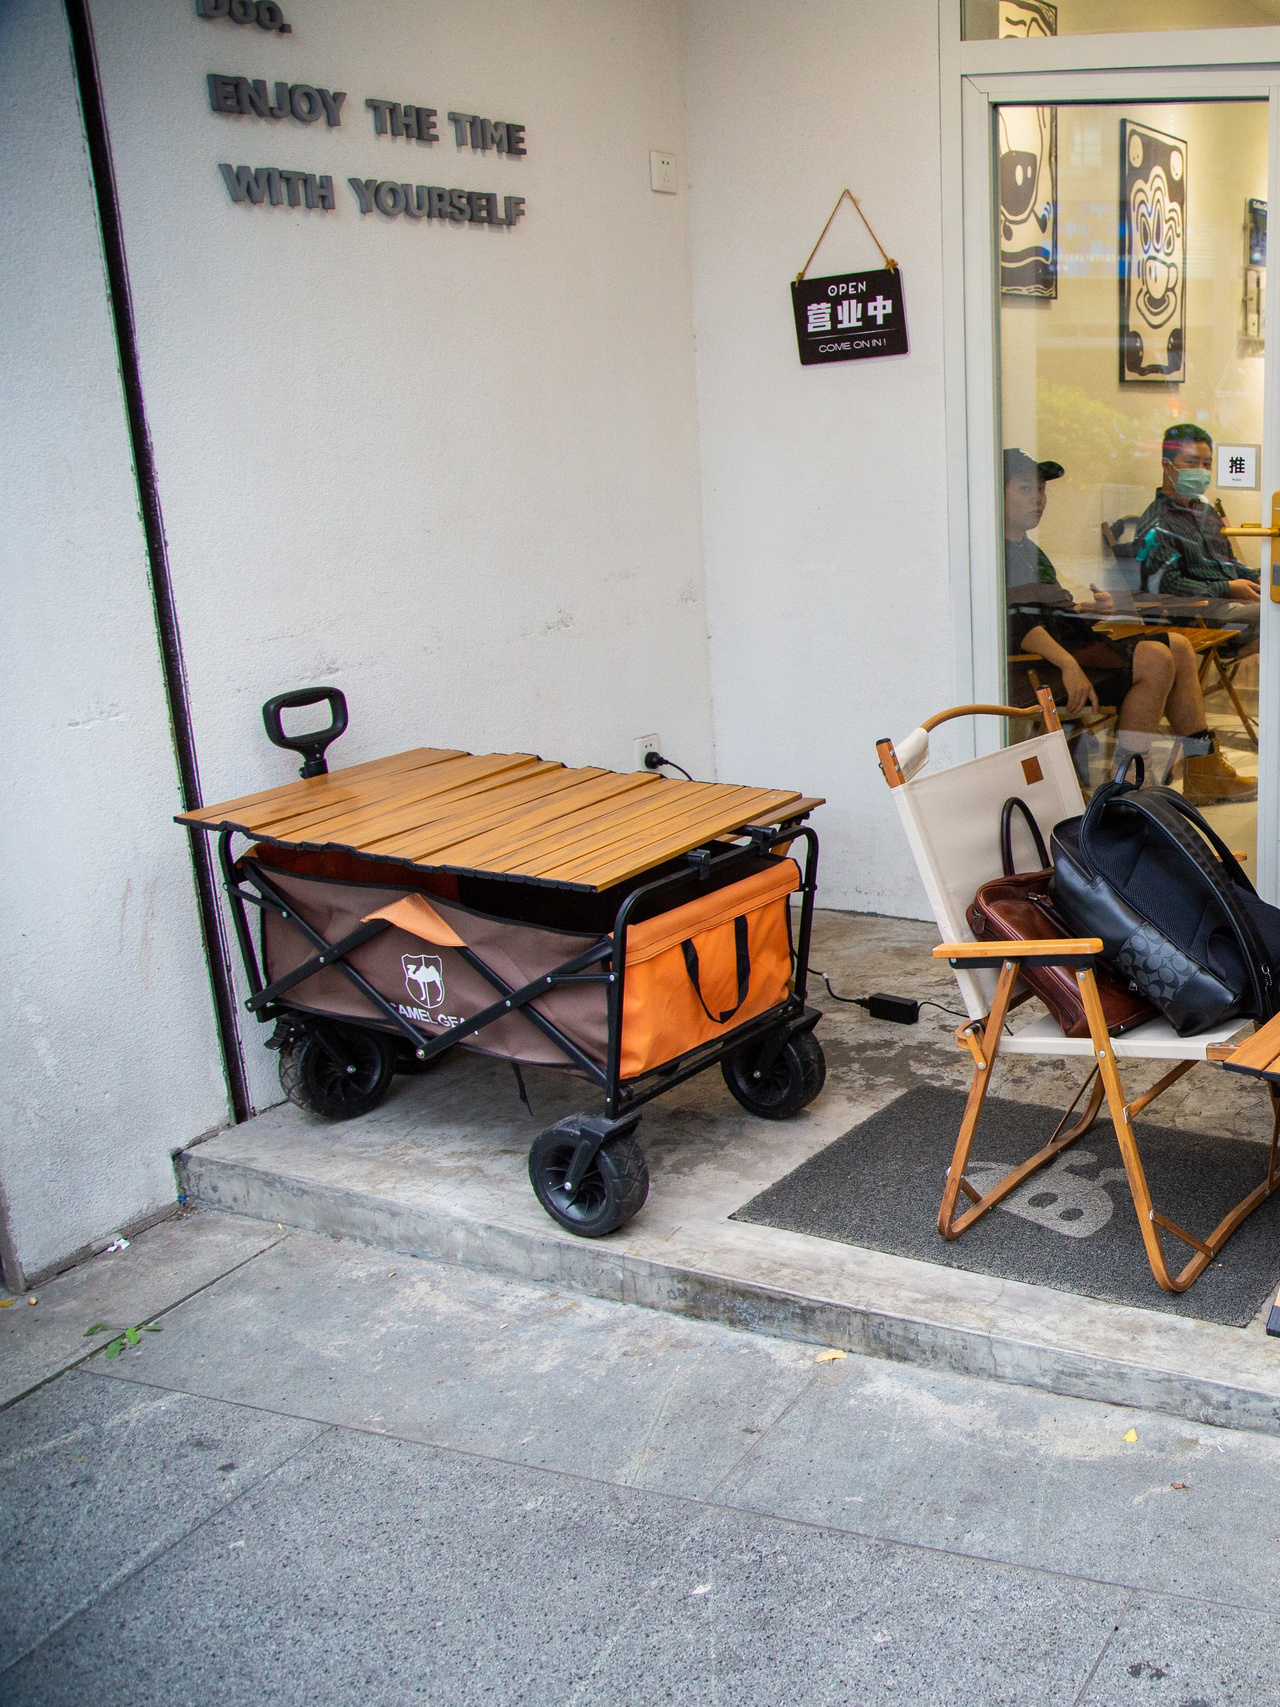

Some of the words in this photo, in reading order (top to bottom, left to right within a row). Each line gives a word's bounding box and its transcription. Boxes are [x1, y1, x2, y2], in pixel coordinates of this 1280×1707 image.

[207, 73, 347, 127] ENJOY
[365, 98, 440, 142] THE
[447, 111, 527, 155] TIME
[218, 163, 336, 210] WITH
[347, 177, 526, 226] YOURSELF
[827, 281, 867, 297] OPEN
[807, 295, 893, 333] 营业中
[818, 341, 852, 353] COME
[853, 340, 870, 349] ON
[1229, 456, 1246, 474] 推
